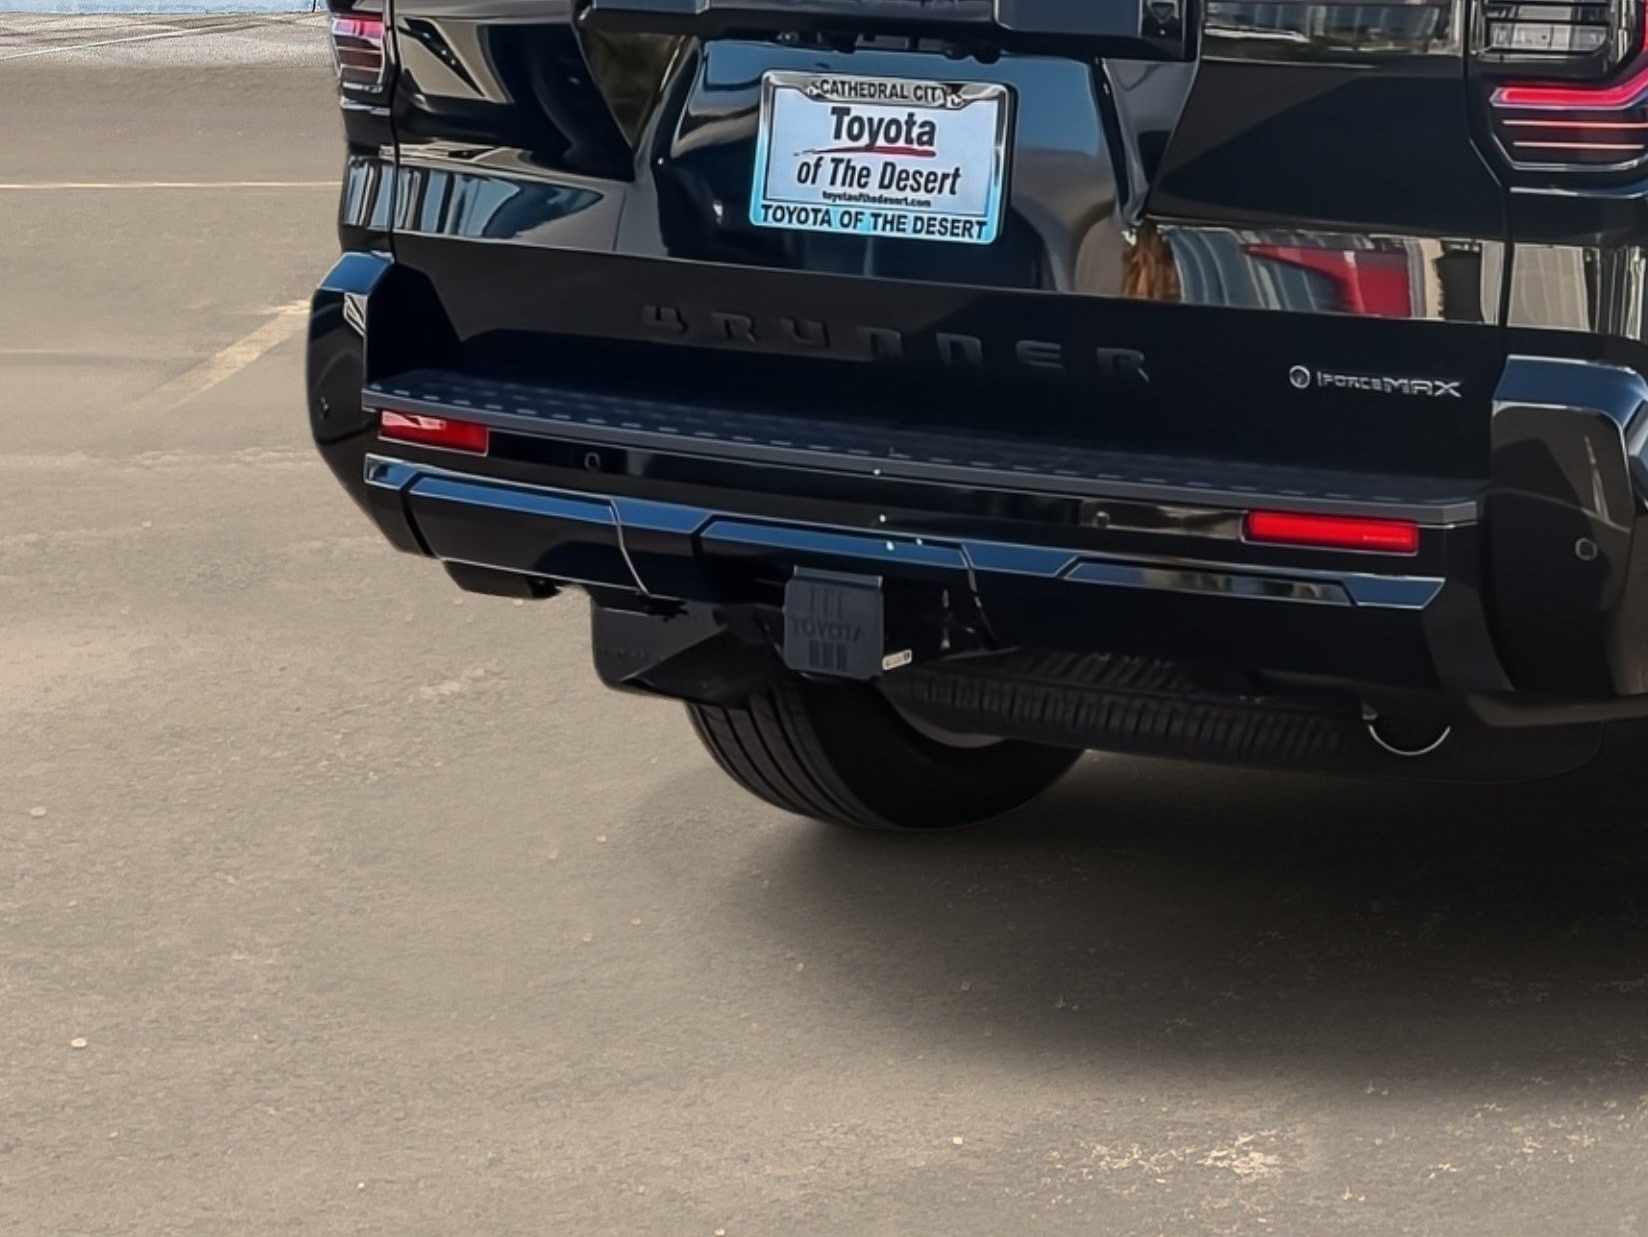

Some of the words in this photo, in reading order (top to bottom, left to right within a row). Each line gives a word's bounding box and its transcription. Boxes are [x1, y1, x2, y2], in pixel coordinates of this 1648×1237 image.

[820, 79, 909, 100] CATHEDRAL
[913, 84, 949, 104] CITY
[830, 106, 936, 148] Toyota
[797, 156, 825, 185] of
[829, 157, 872, 190] The
[878, 161, 962, 196] Desert
[761, 204, 833, 228] TOYOTA
[839, 210, 865, 230] OF
[870, 212, 906, 233] THE
[912, 215, 988, 241] DESERT
